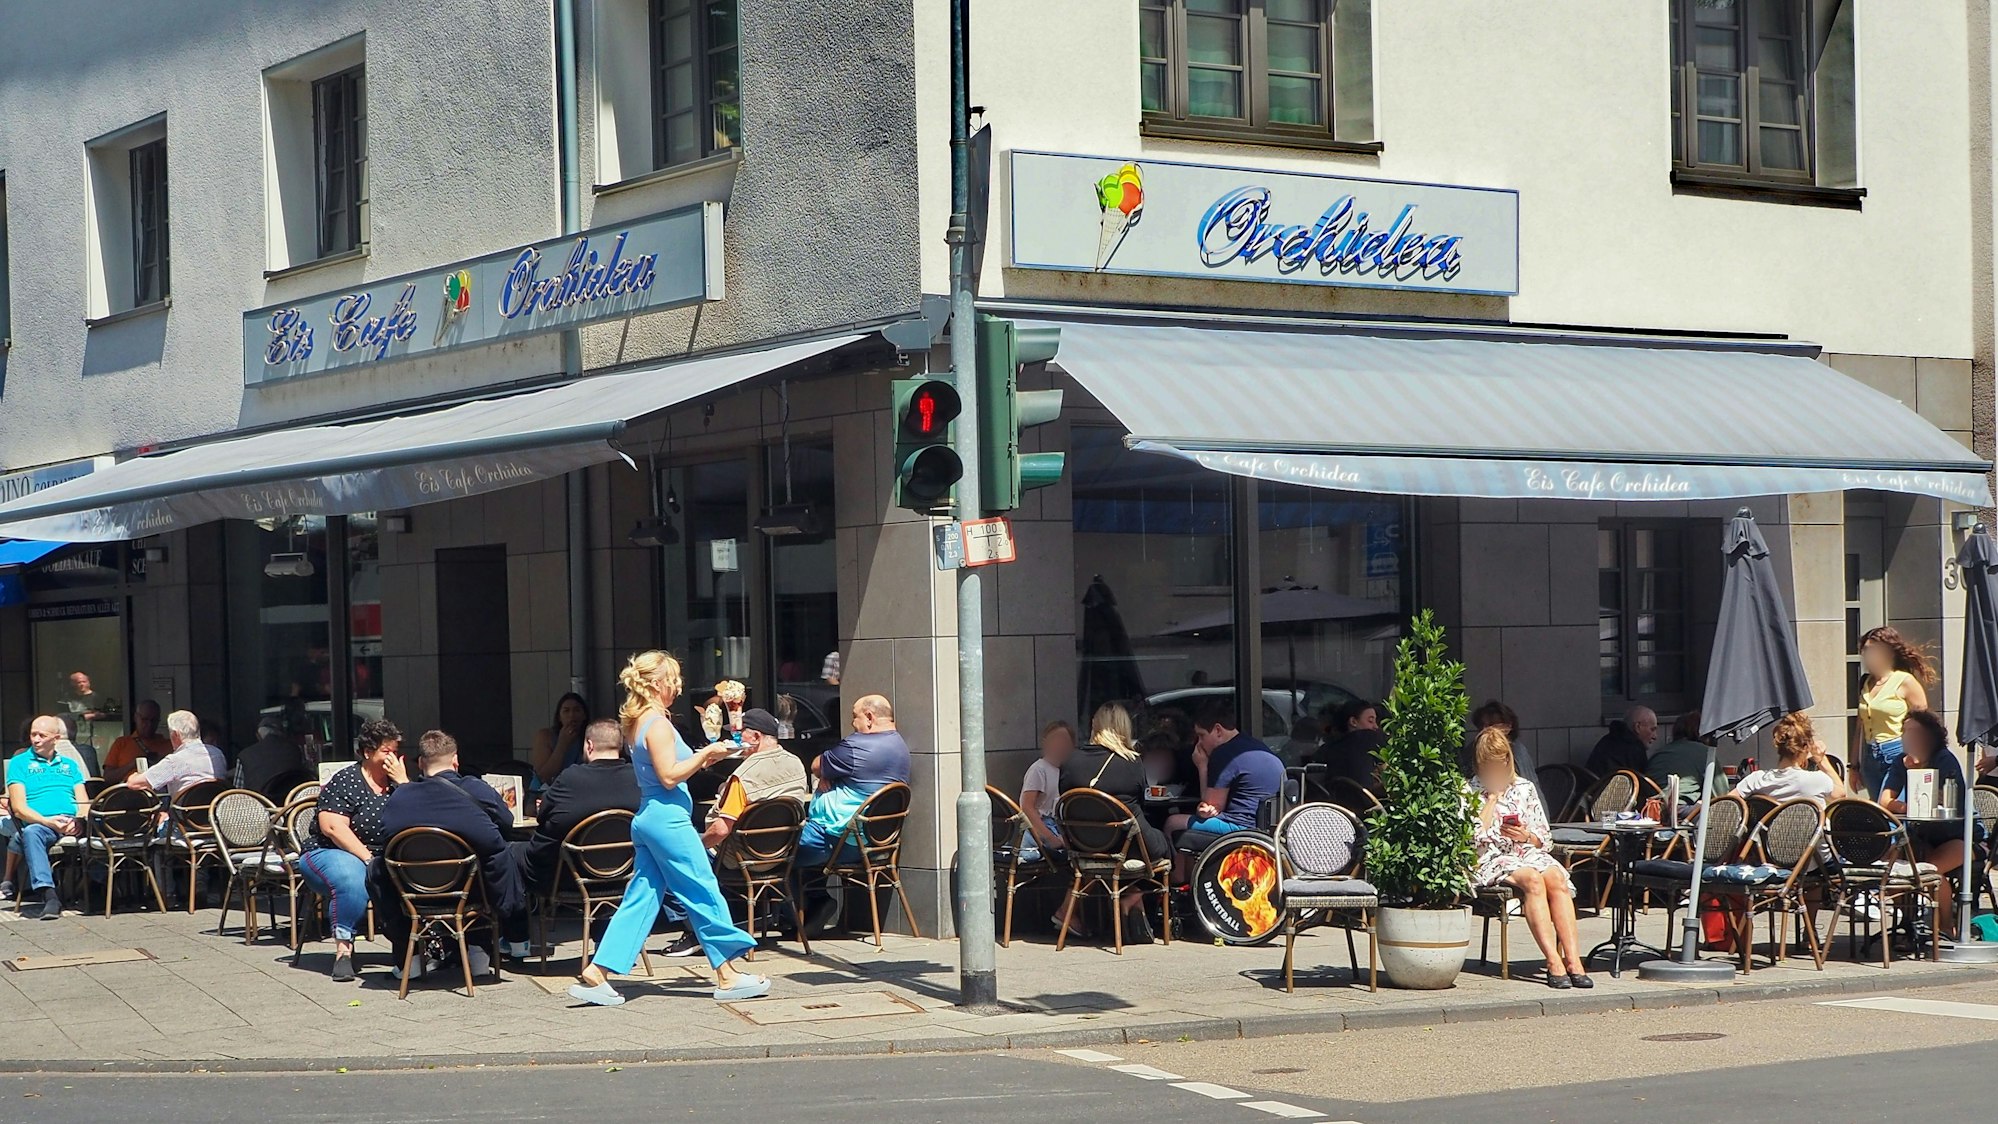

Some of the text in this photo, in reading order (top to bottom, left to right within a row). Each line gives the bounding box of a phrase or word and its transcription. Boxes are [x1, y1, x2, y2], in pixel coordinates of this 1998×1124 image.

[1197, 185, 1463, 275] Orchidea
[264, 307, 314, 365] Eis
[498, 231, 659, 319] Orchidea
[415, 462, 533, 495] Eis Cafe Orchidea
[1274, 458, 1361, 483] Orchidea
[1524, 468, 1691, 498] Eis Cafe Orchidea
[241, 493, 263, 513] Eis
[967, 527, 973, 536] H
[981, 523, 998, 534] 100
[1204, 881, 1240, 931] BASKETBALL
